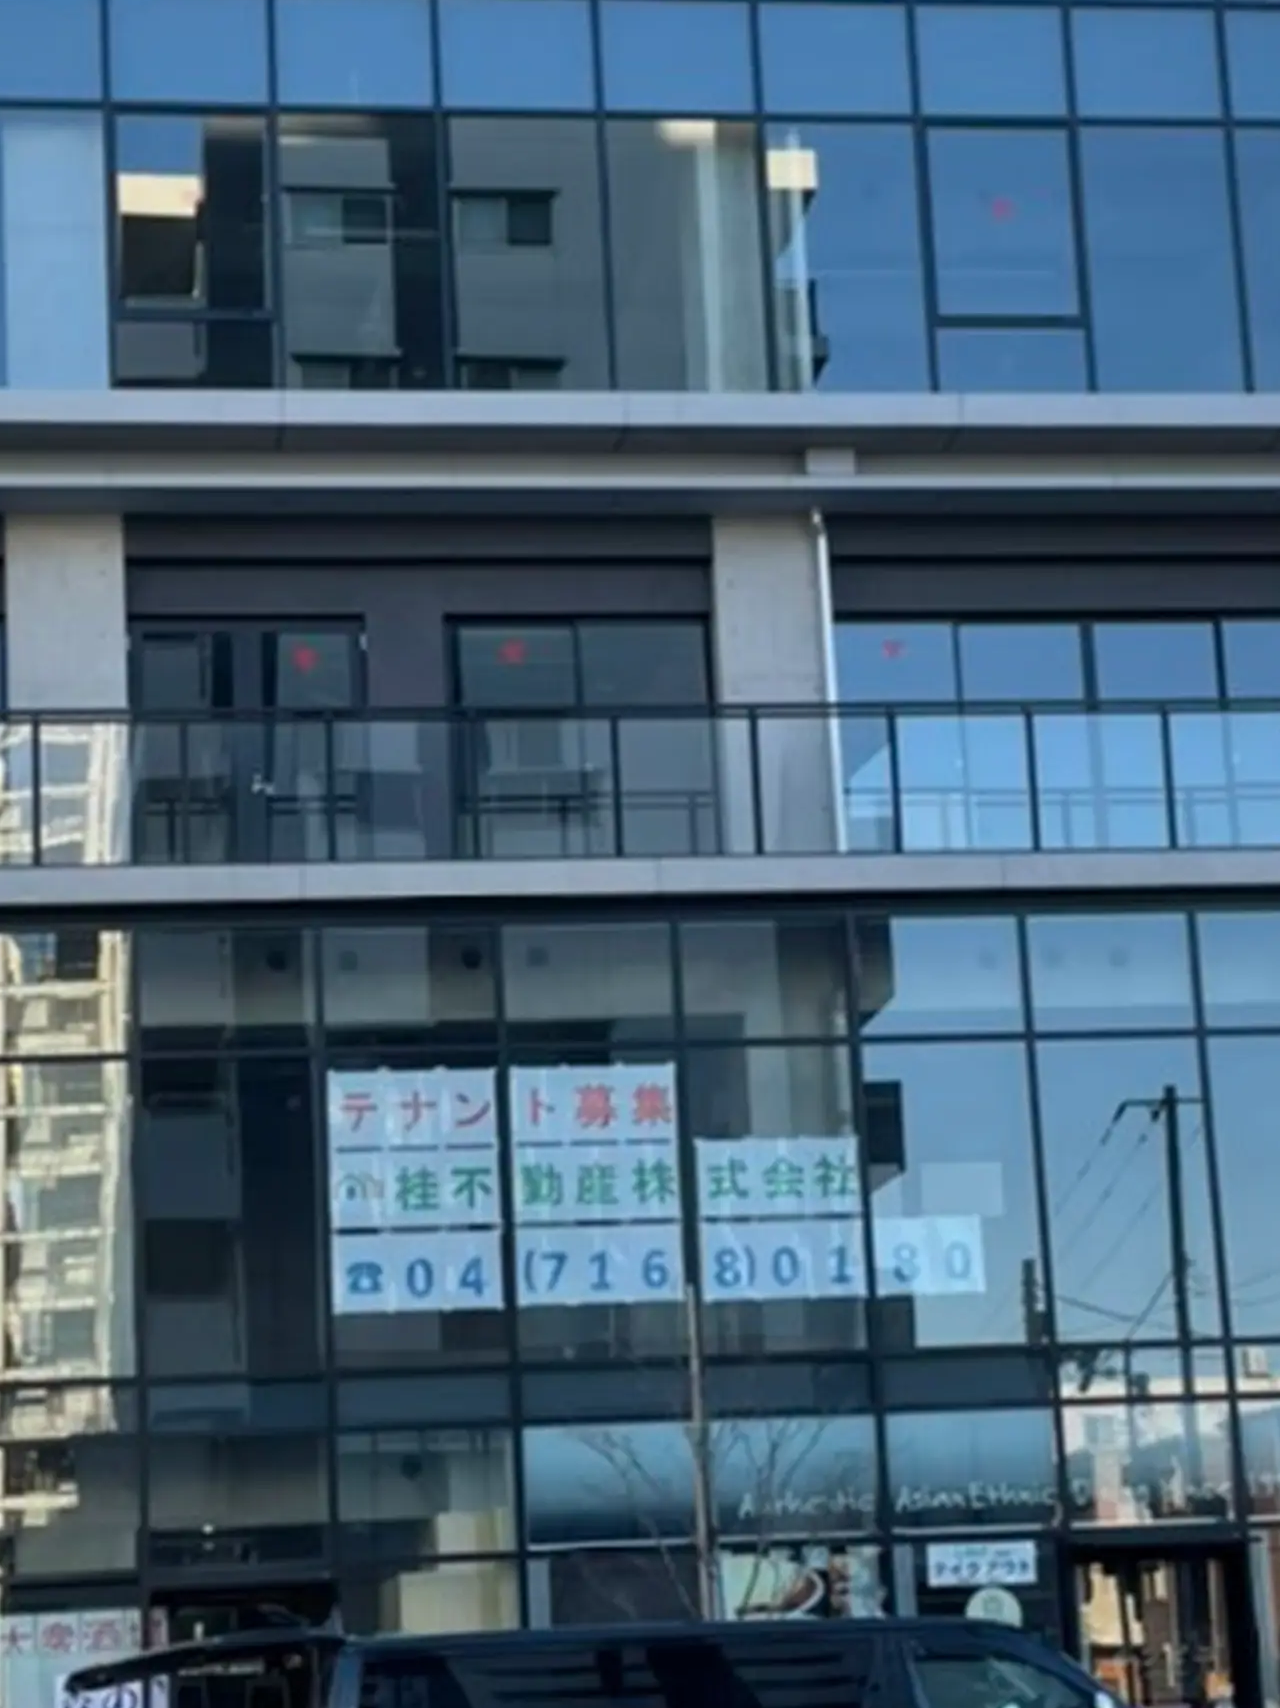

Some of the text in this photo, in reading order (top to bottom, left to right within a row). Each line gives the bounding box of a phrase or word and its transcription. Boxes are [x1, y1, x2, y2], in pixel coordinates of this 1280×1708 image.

[341, 1083, 672, 1132] テナント募集
[394, 1156, 856, 1211] 桂不動産株式会社
